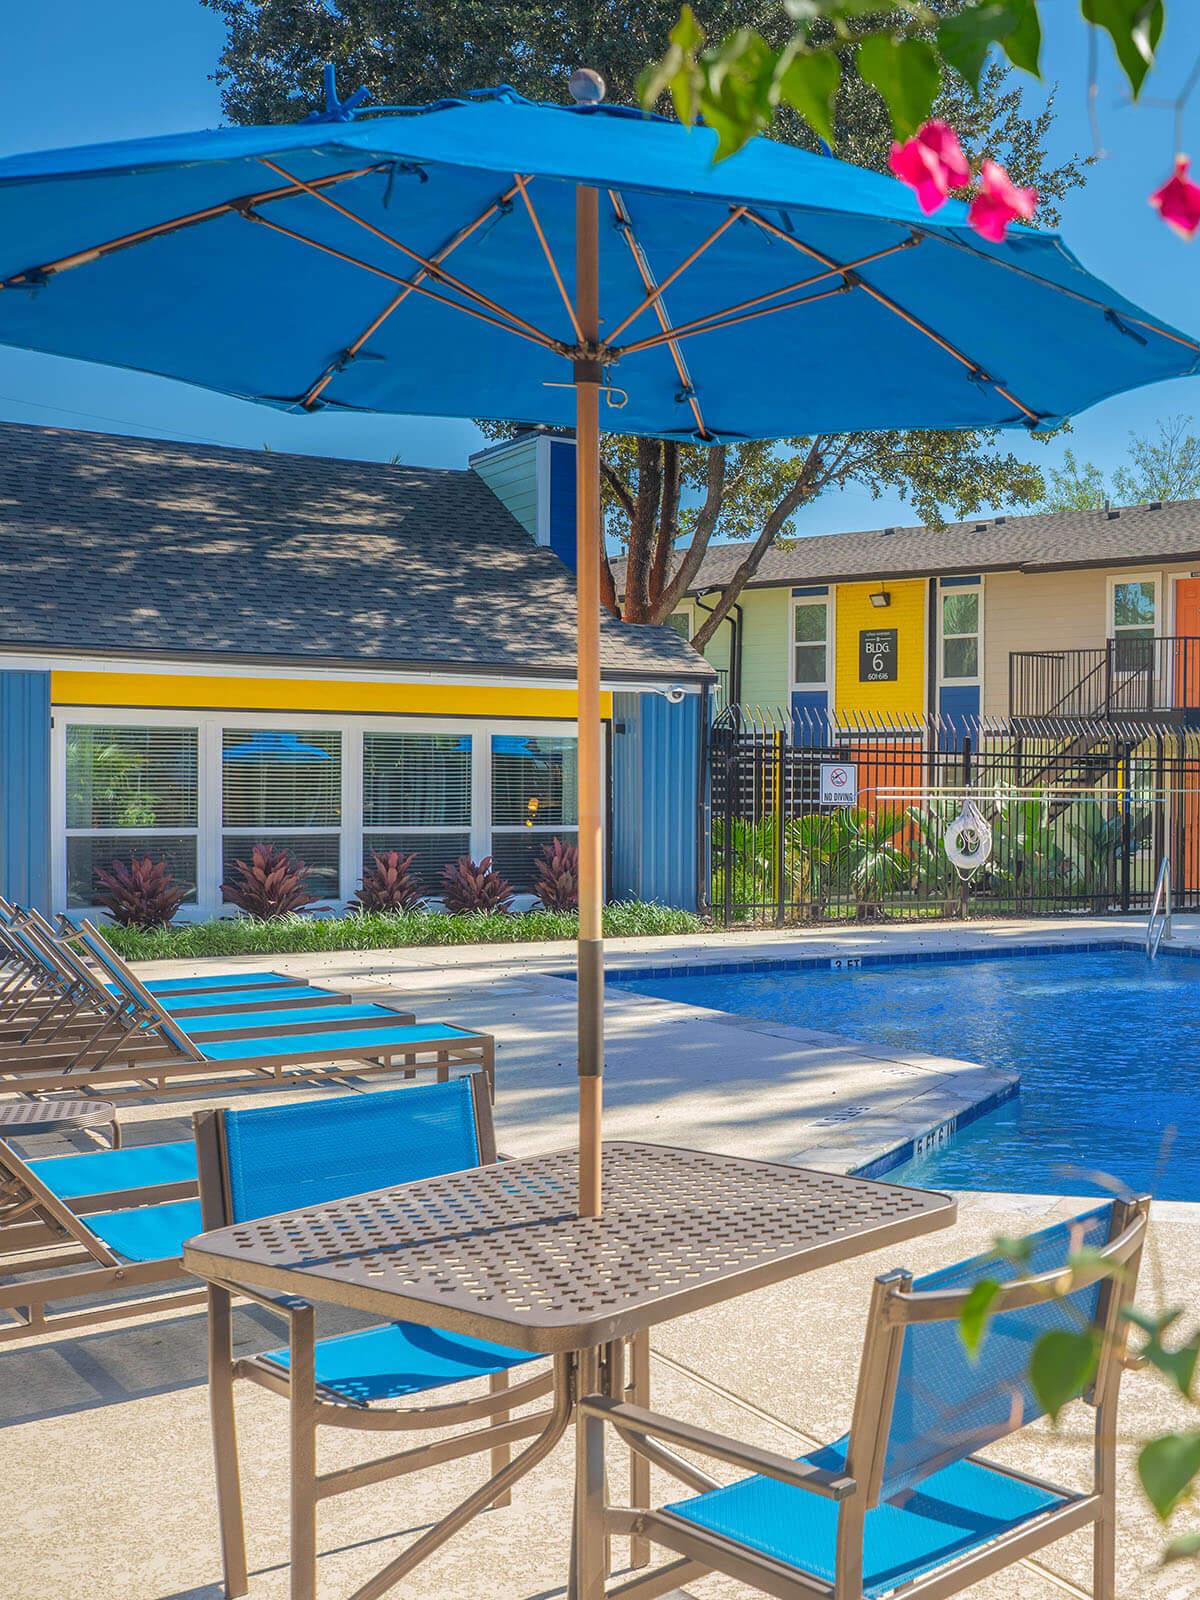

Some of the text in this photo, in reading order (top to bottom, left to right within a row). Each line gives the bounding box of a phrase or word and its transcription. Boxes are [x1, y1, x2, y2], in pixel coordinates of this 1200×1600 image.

[873, 653, 884, 671] 6
[824, 792, 853, 801] NO DIVING
[847, 959, 860, 969] FT
